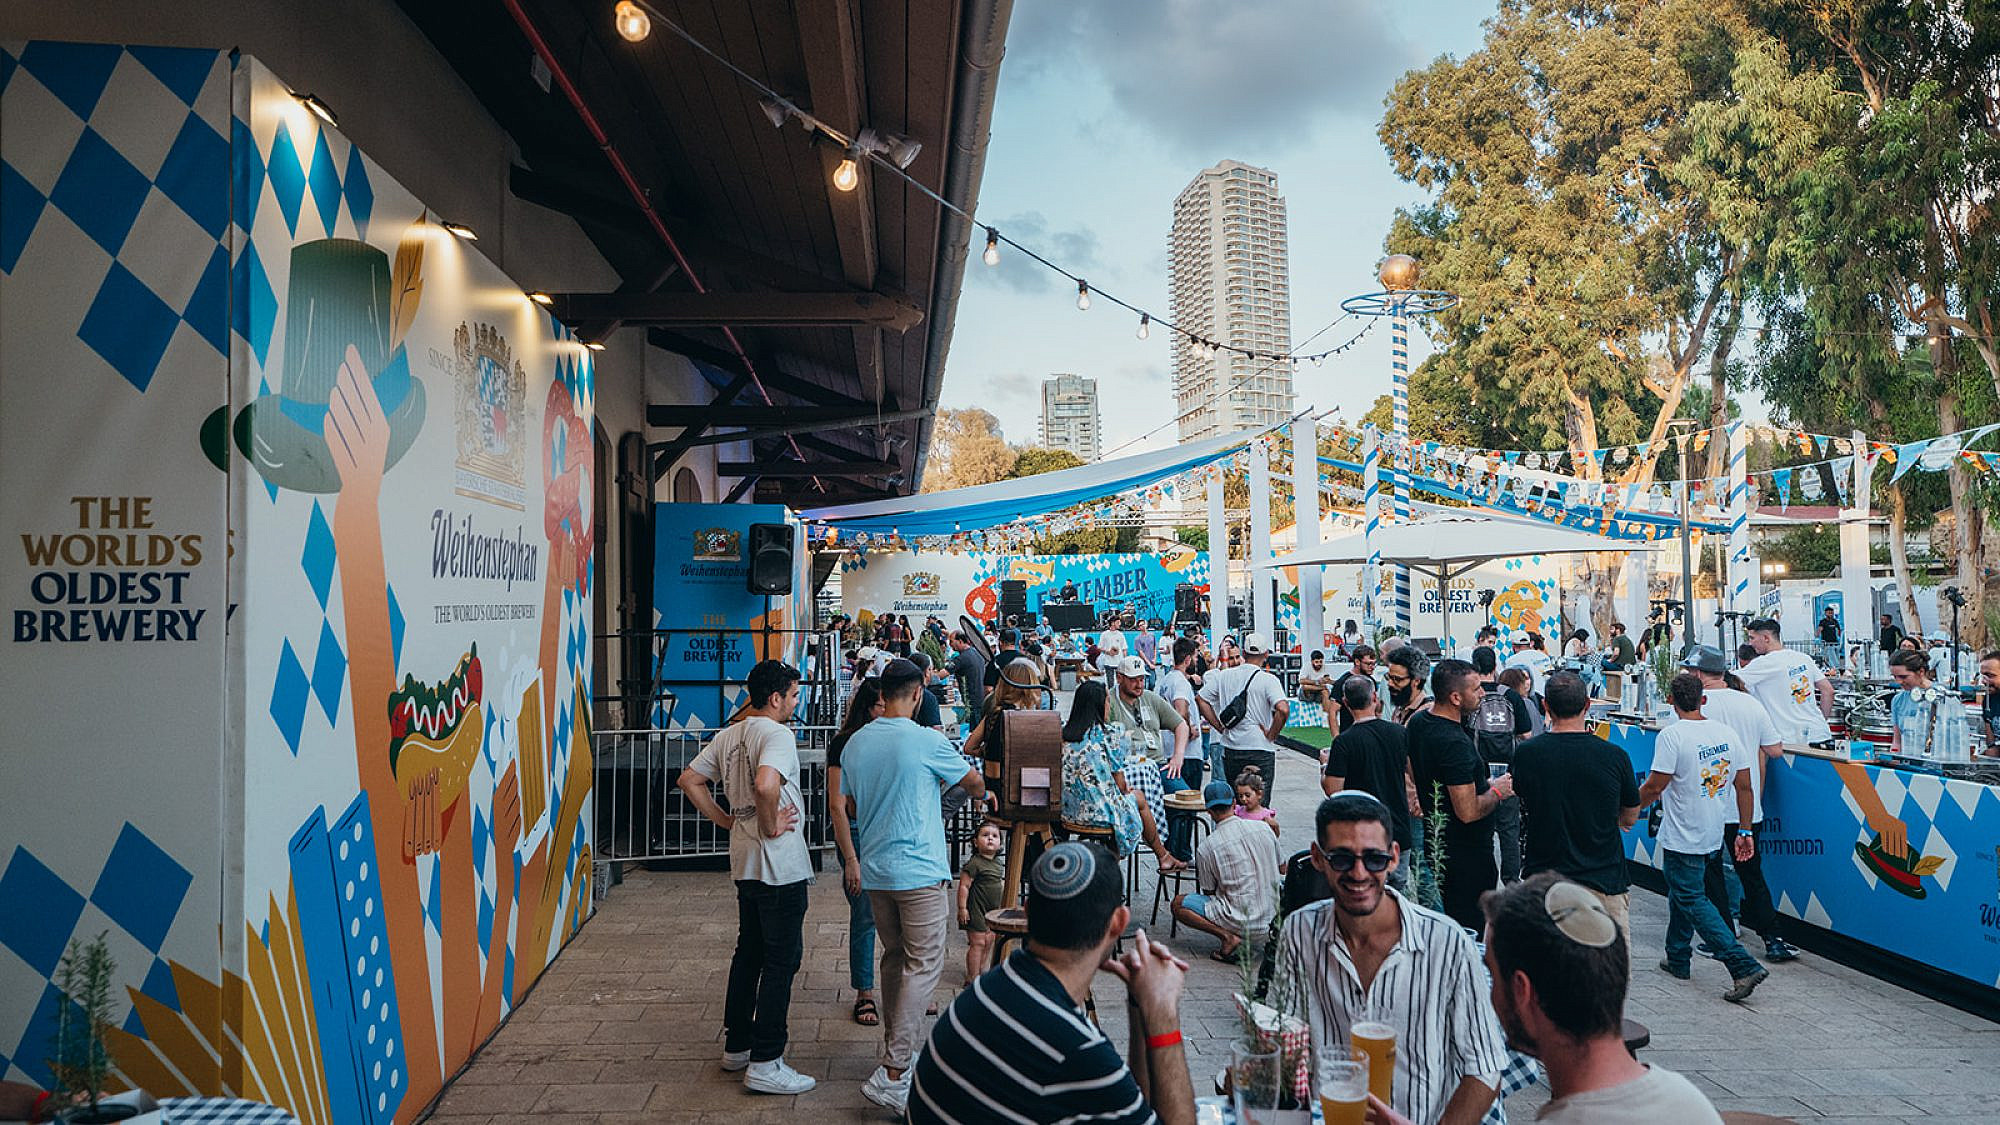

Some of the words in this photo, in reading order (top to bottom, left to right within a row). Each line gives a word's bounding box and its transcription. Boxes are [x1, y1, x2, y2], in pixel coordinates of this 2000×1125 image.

[70, 496, 155, 529] THE
[21, 534, 202, 566] WORLD'S
[431, 508, 537, 592] Weihenstephan
[31, 572, 190, 605] OLDEST
[1421, 577, 1476, 589] WOLD'S
[1424, 589, 1472, 601] OLEST
[13, 609, 206, 642] BREWERY
[433, 605, 451, 624] THE
[486, 604, 509, 620] OLDEST
